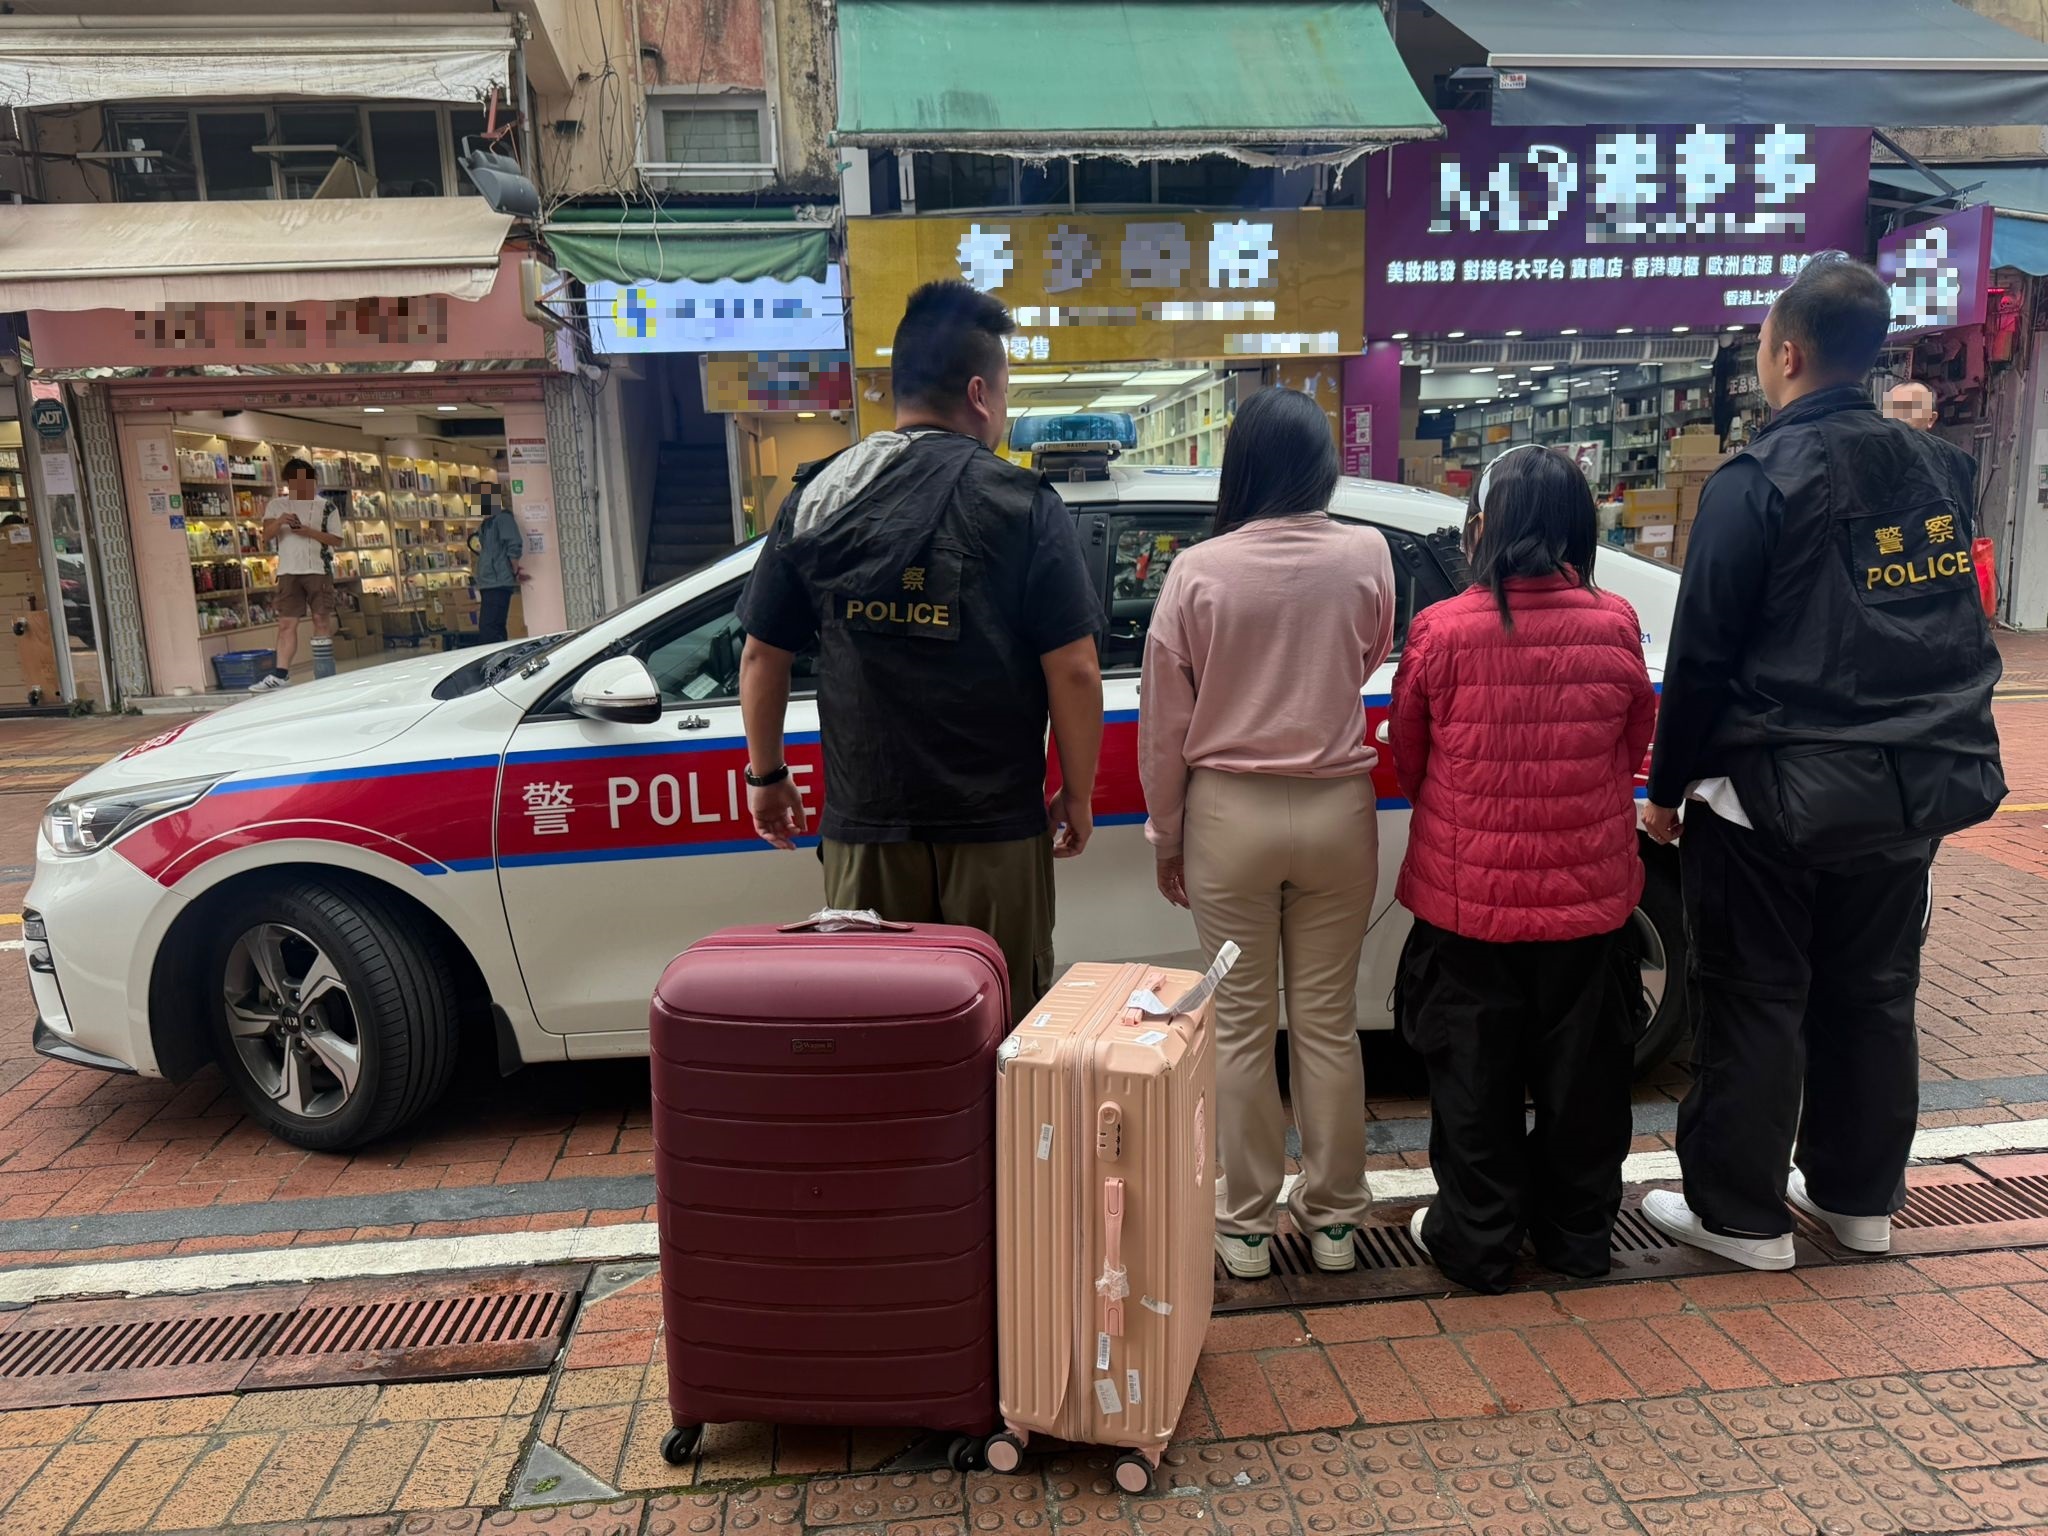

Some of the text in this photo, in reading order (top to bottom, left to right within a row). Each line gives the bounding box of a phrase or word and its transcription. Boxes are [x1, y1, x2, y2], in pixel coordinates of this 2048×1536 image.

[1387, 260, 1456, 283] 美妝批發
[1463, 258, 1565, 281] 對接各大平台
[1632, 256, 1700, 278] 香港專櫃
[1706, 254, 1774, 276] 歐洲貨源
[1724, 289, 1783, 307] 香港上水
[37, 411, 63, 425] ADT
[1873, 514, 1954, 555] 警 察
[901, 566, 926, 591] 察
[1866, 551, 1971, 590] POLICE
[846, 600, 949, 626] POLICE
[522, 763, 816, 835] 警 POLIE
